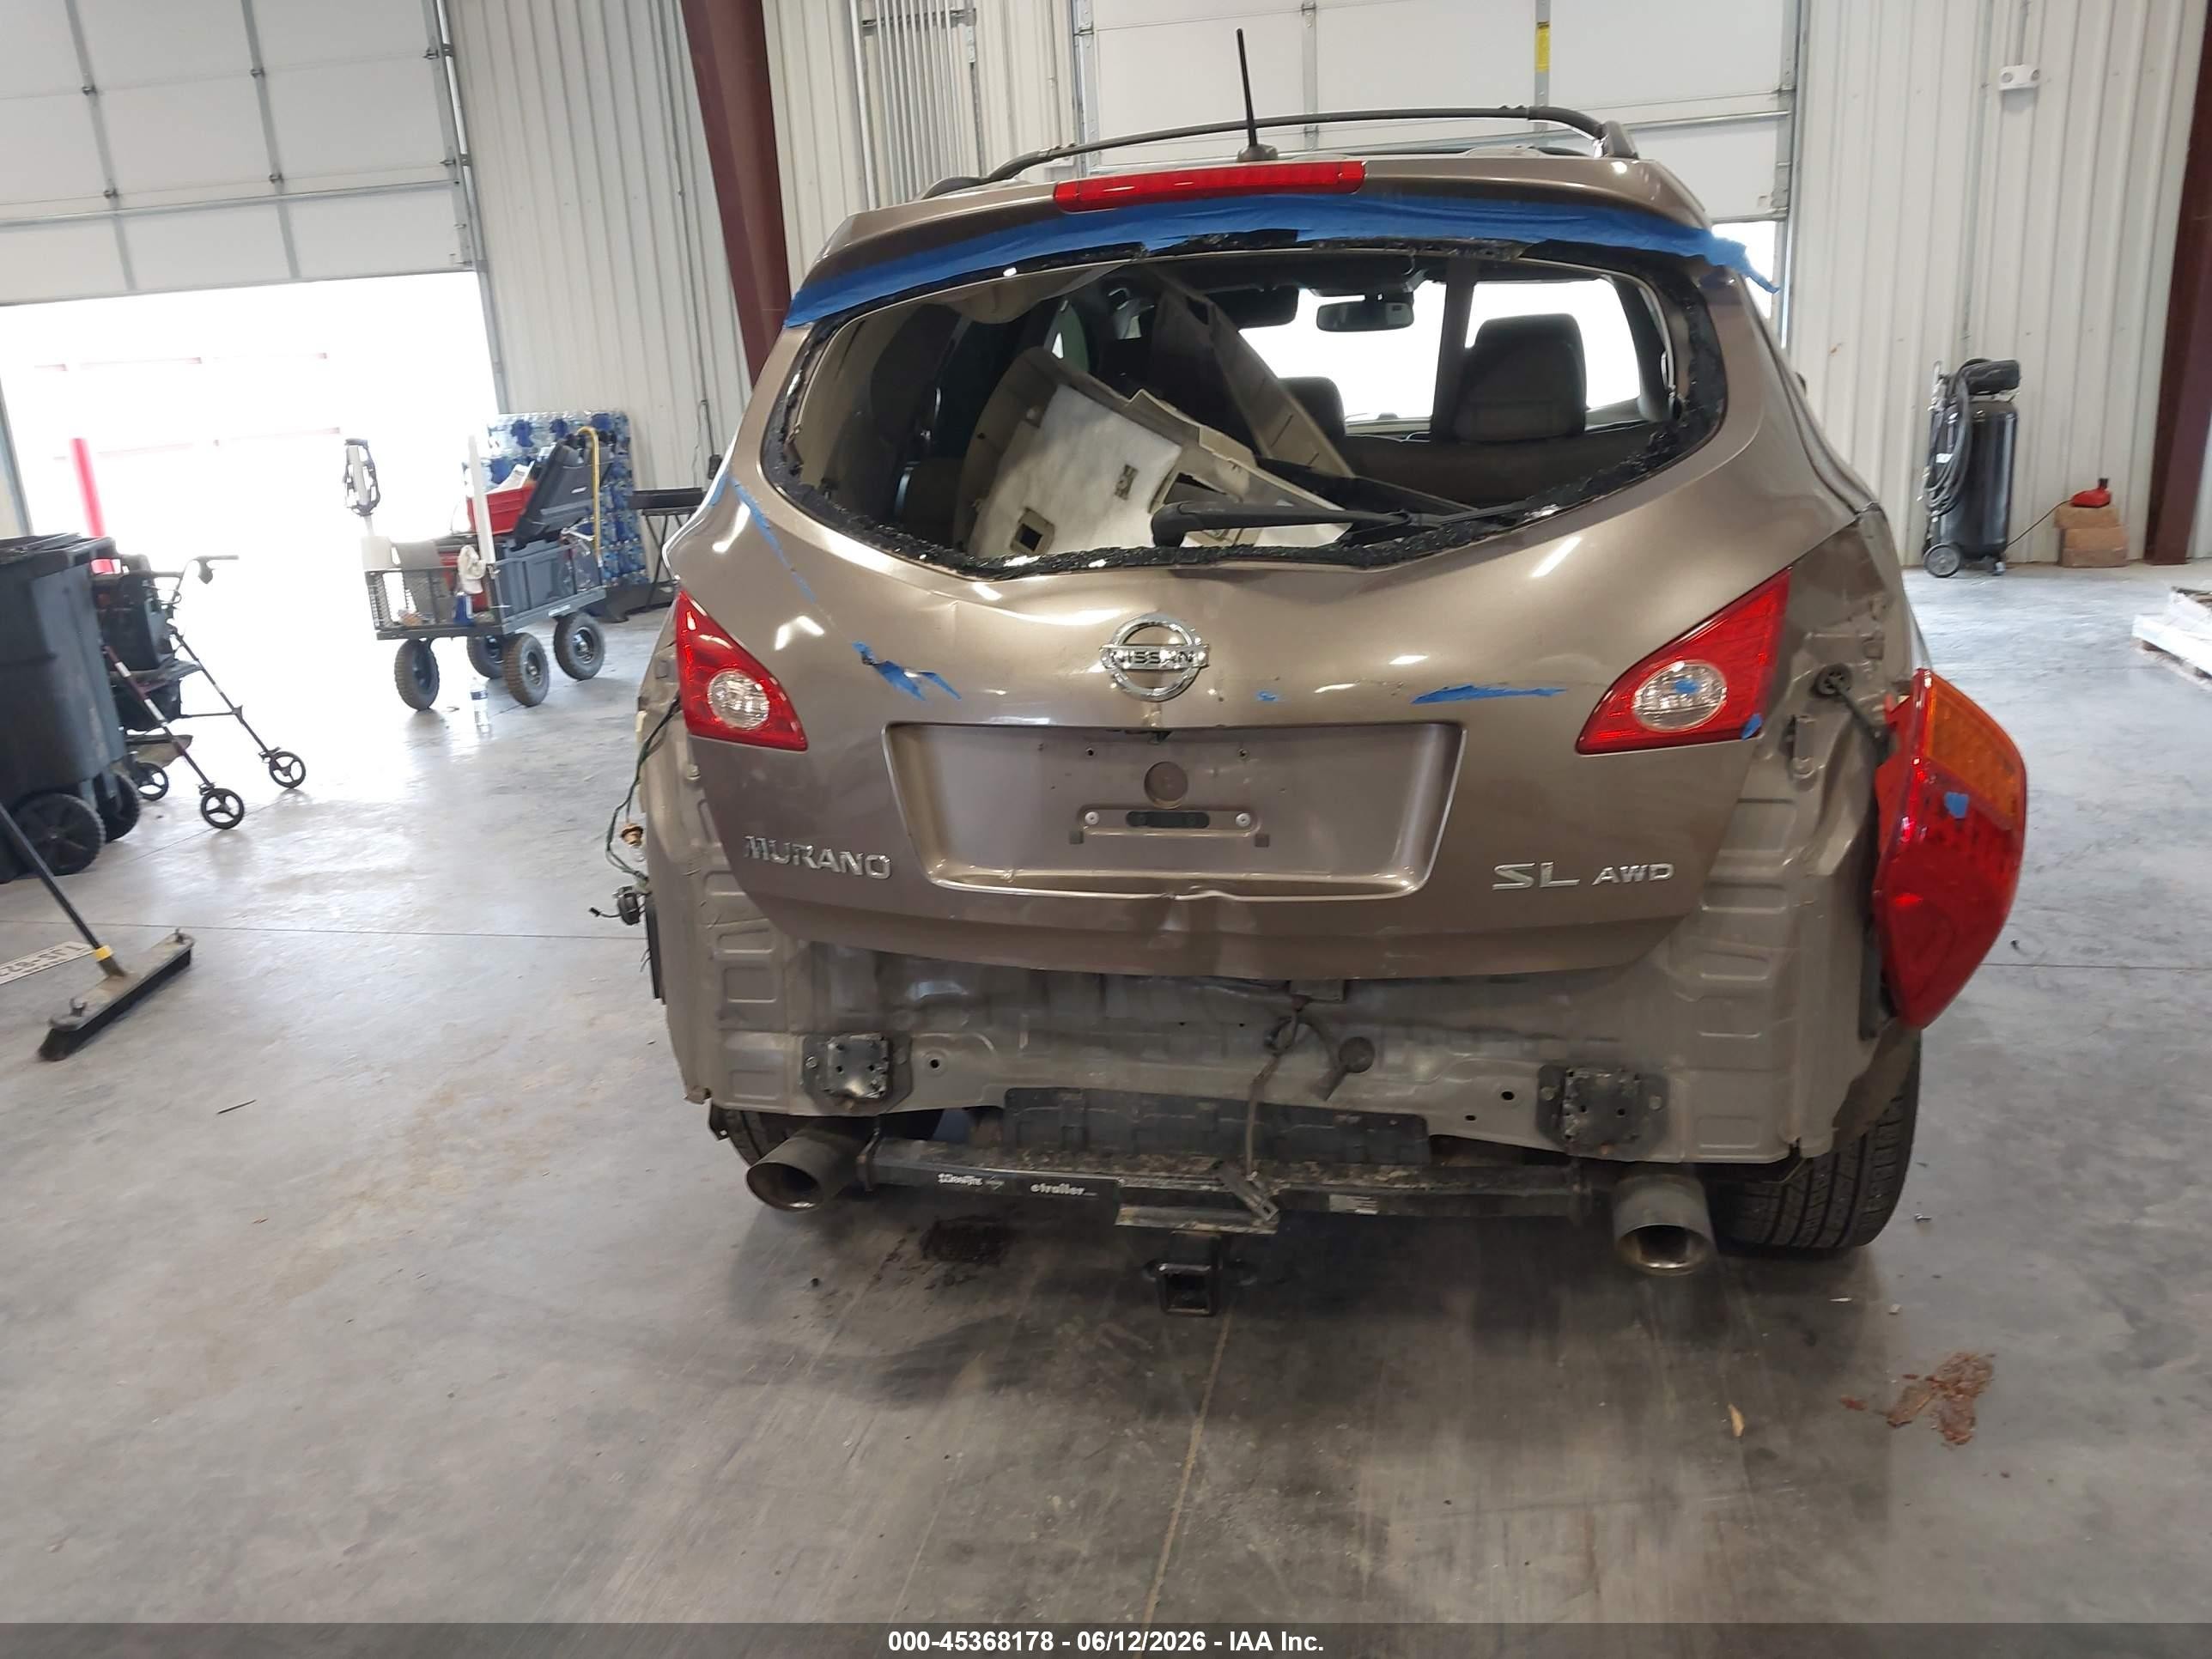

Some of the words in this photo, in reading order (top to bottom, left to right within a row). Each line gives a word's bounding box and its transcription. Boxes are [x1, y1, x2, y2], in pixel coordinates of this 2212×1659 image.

[1109, 650, 1196, 666] NISSAN
[744, 836, 891, 879] MURANO
[1492, 861, 1581, 890] SL
[1591, 863, 1674, 885] AWD
